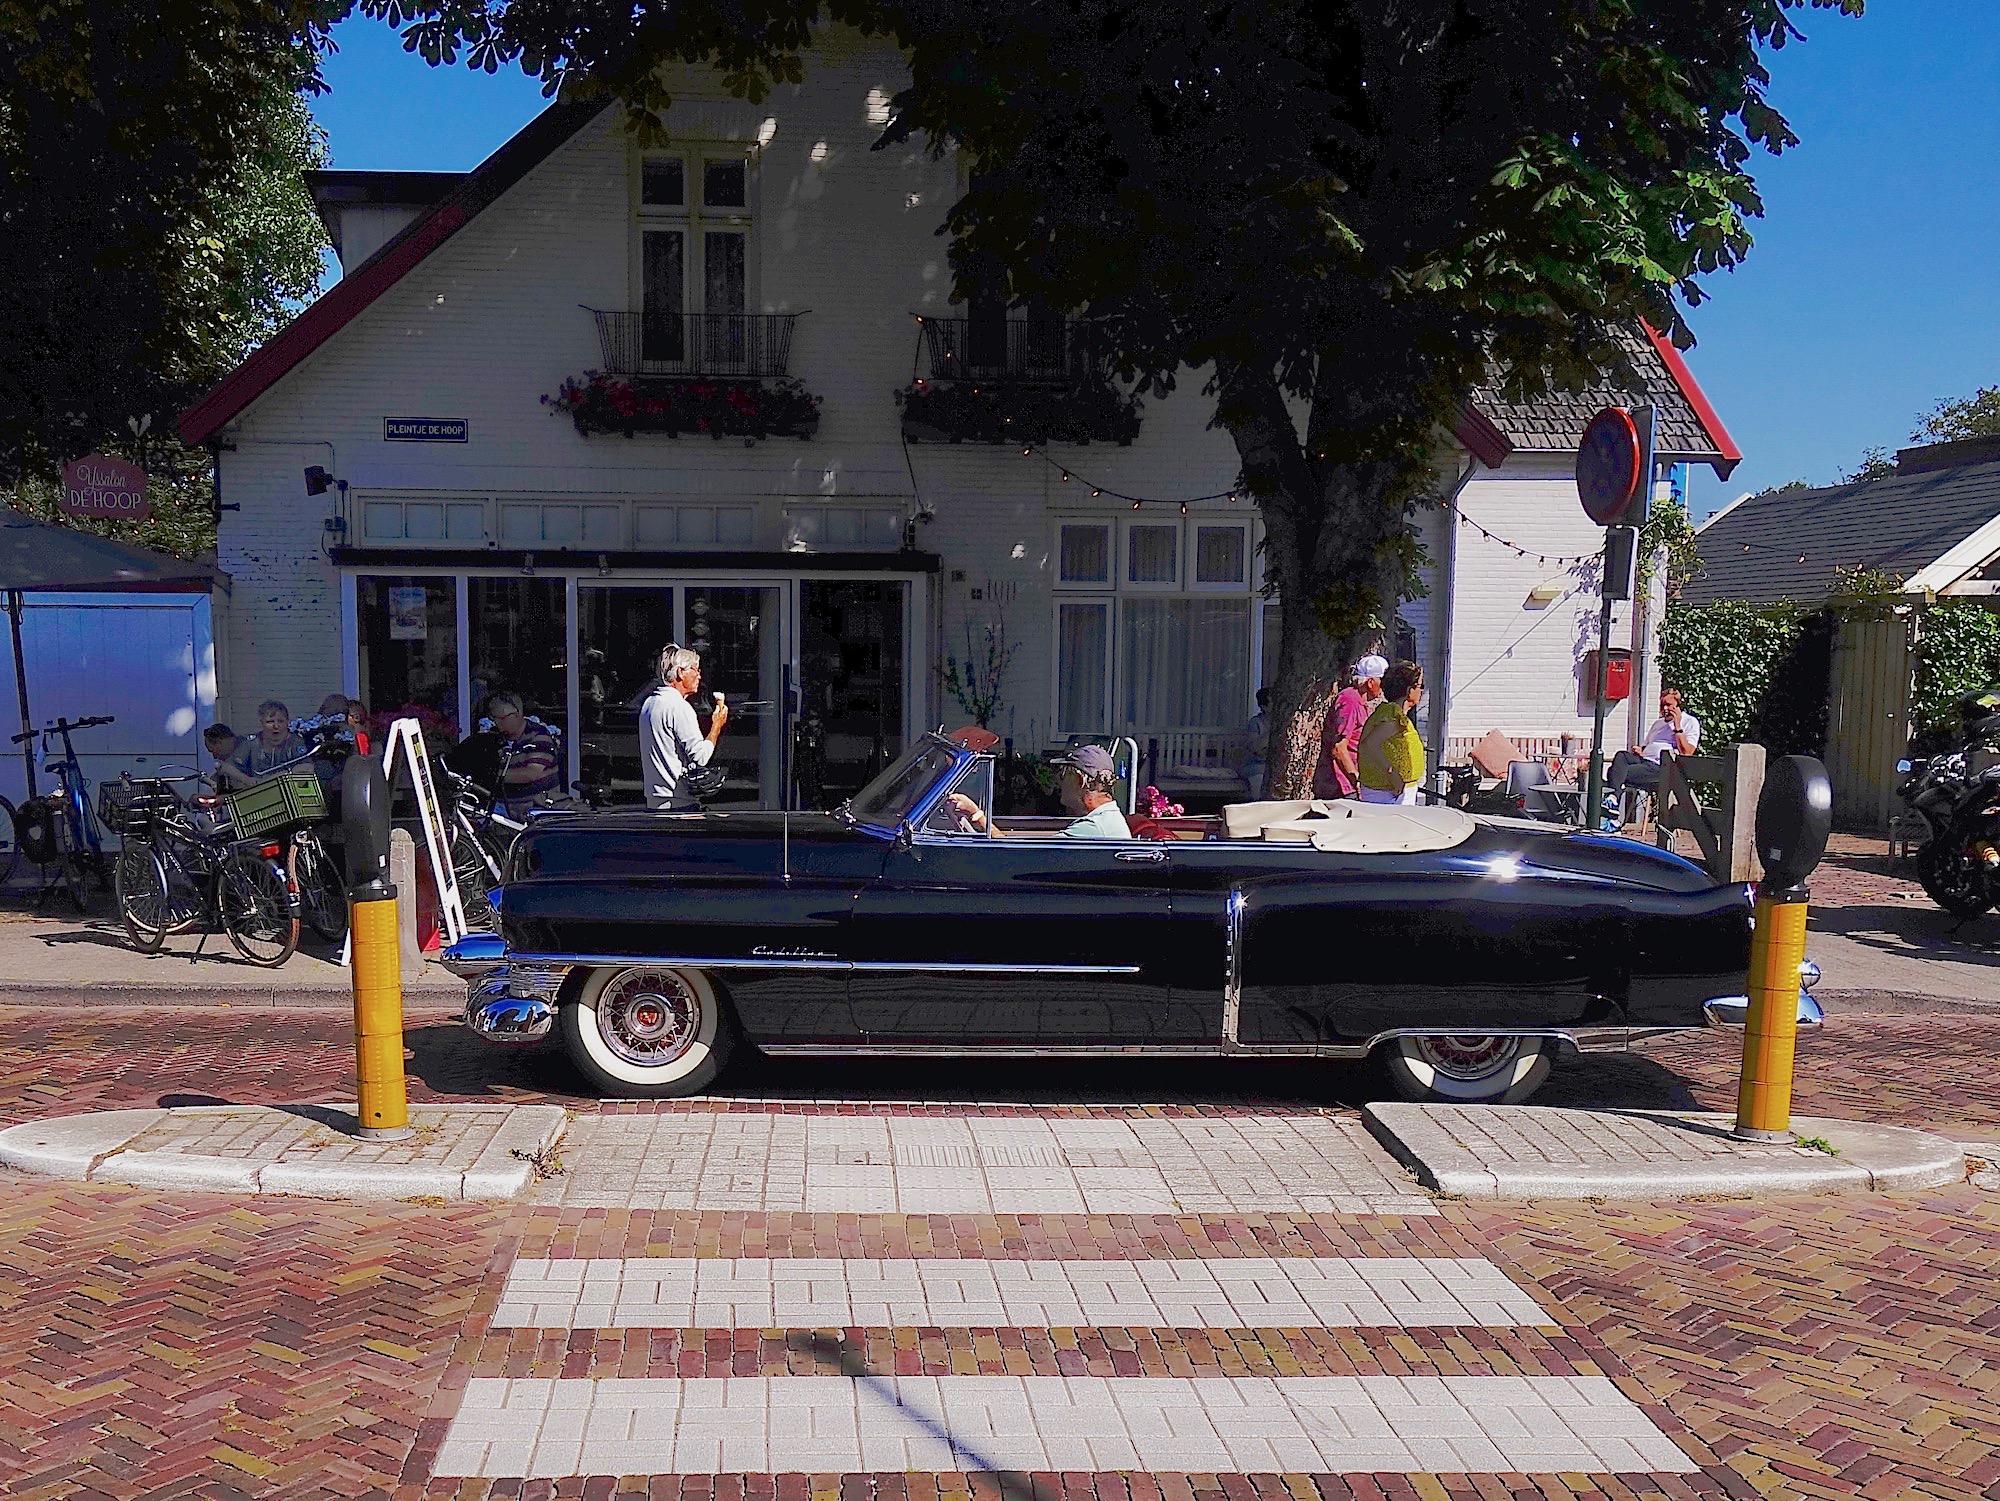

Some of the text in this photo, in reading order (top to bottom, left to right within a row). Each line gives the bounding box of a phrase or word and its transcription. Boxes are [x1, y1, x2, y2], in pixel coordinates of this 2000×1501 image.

[388, 424, 464, 435] PLEINTJE DE HOOP
[77, 465, 126, 496] Yssalon
[70, 489, 142, 510] DE HOOP
